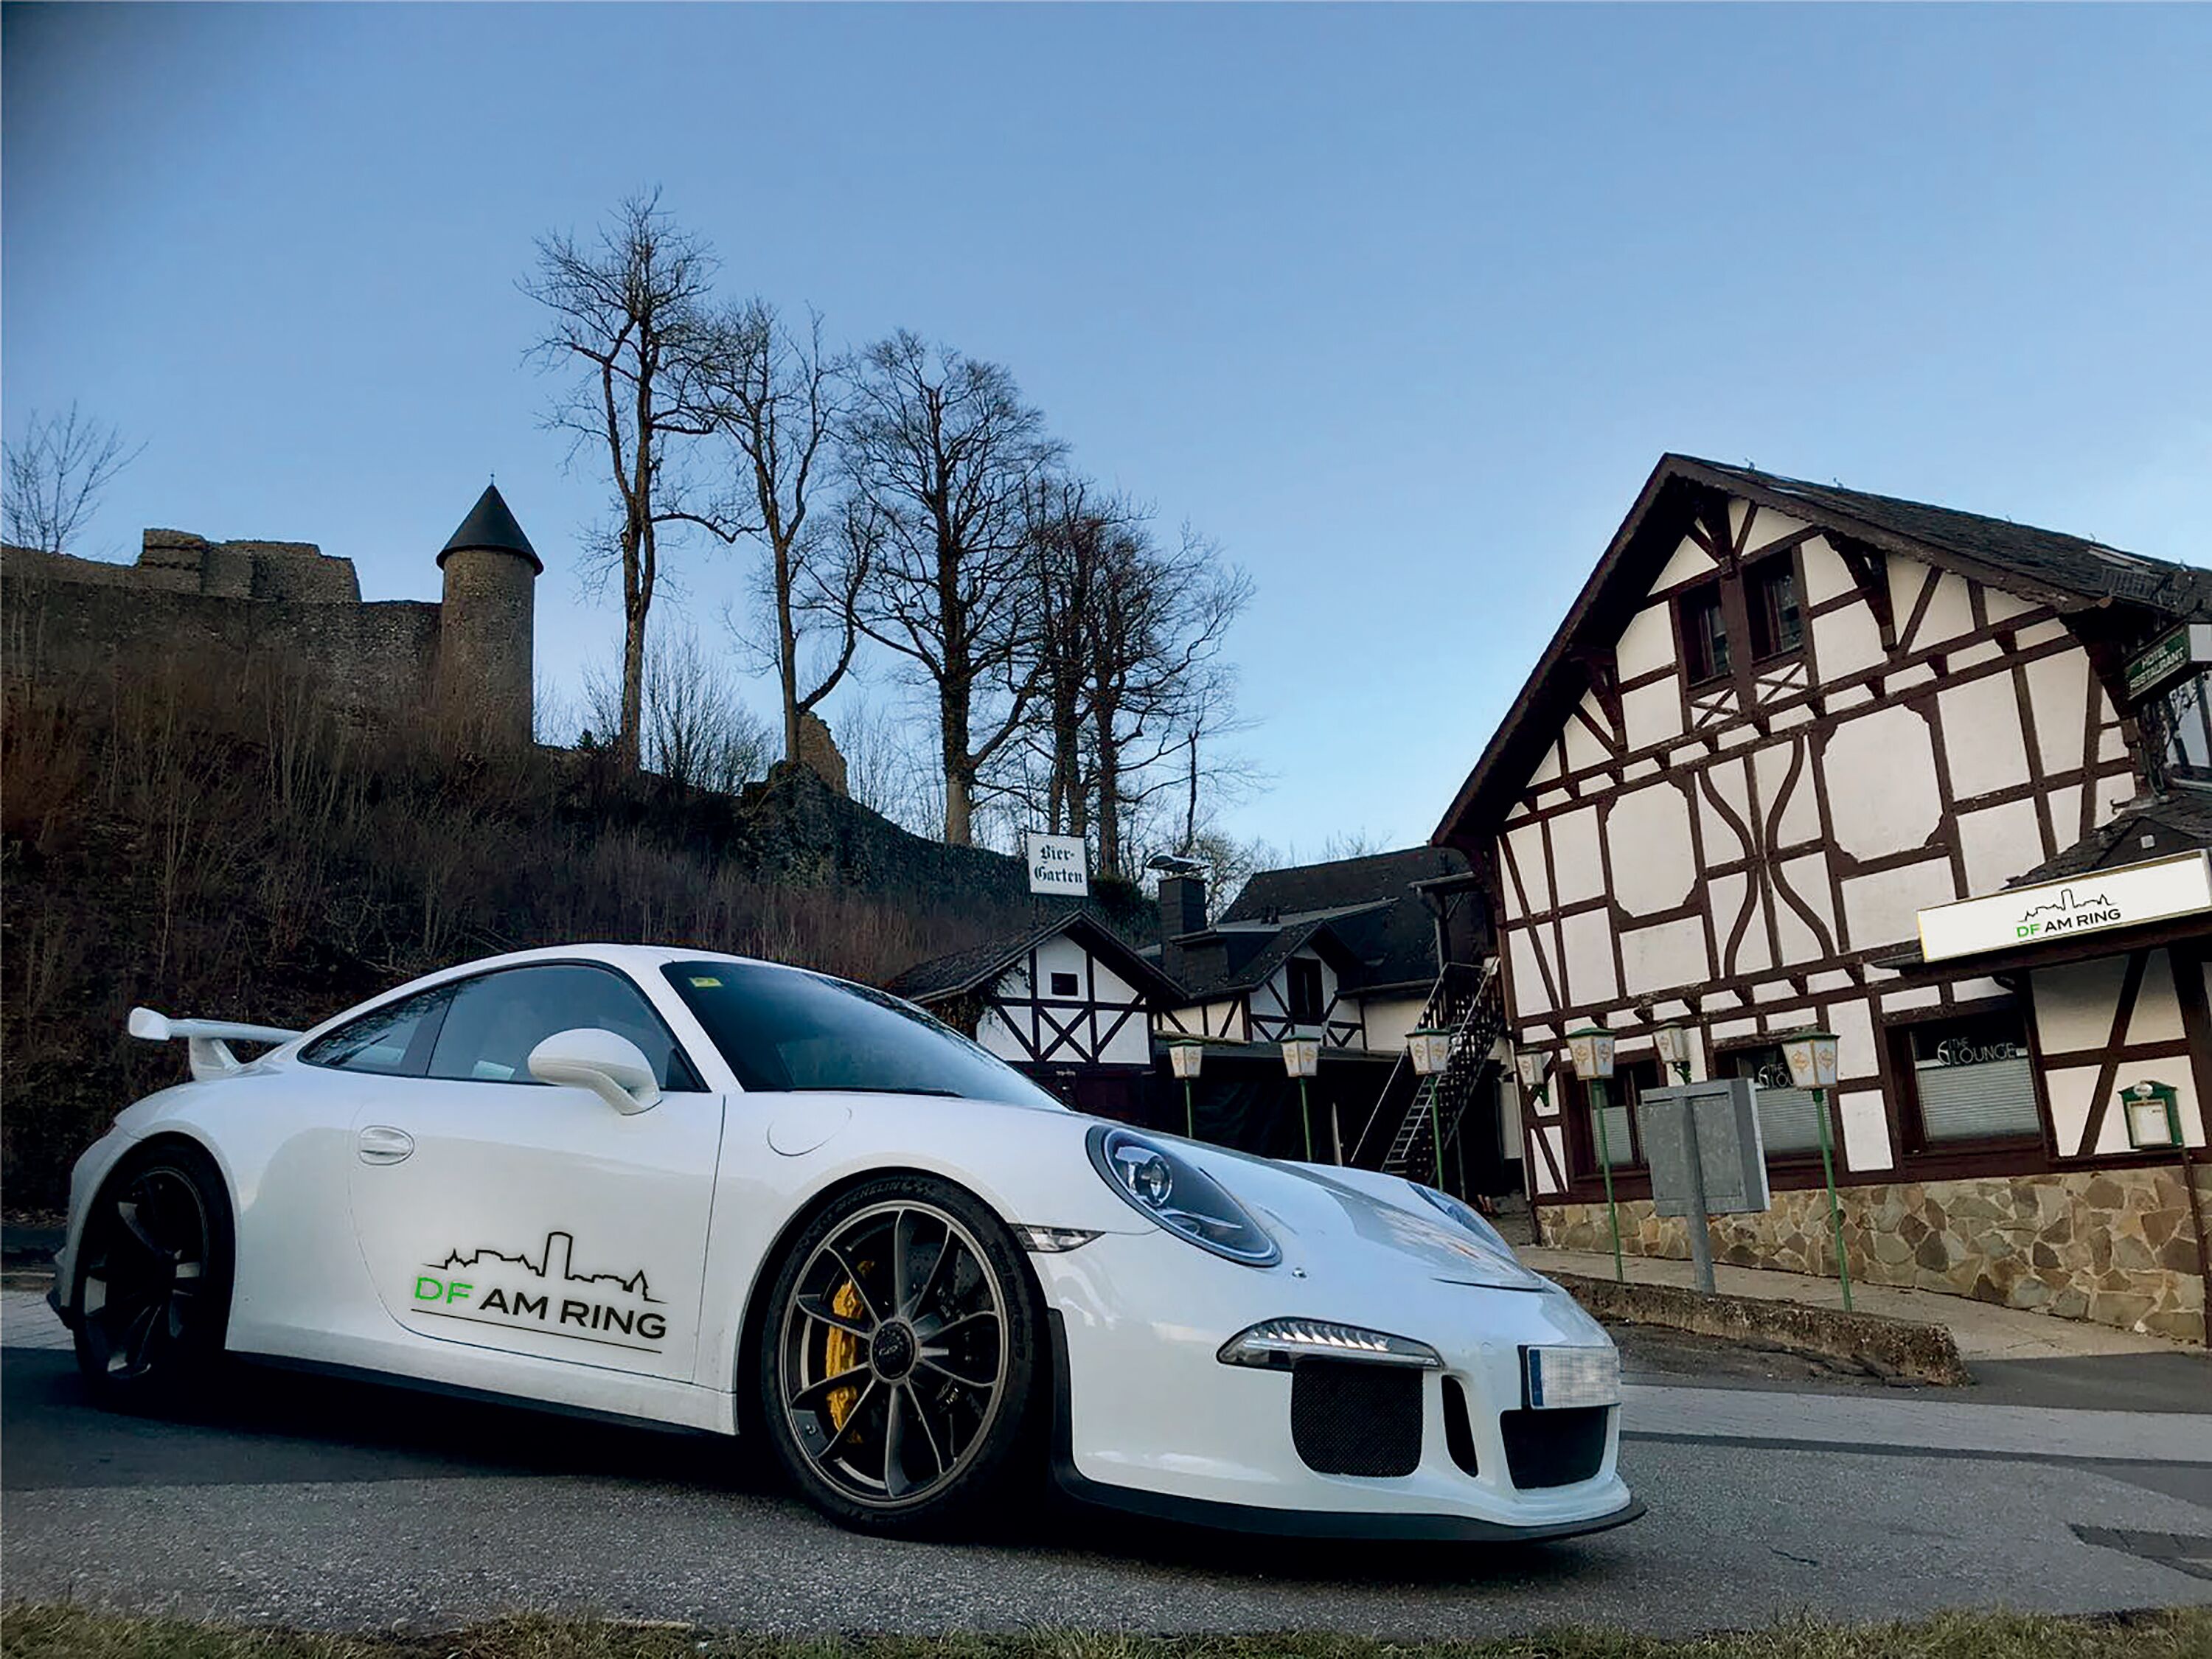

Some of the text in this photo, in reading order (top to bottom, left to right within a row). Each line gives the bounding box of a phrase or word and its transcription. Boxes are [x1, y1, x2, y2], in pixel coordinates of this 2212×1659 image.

[1040, 845, 1075, 861] Bier-
[1034, 866, 1083, 883] Garten
[2016, 908, 2121, 938] DF AM RING
[1952, 1042, 2015, 1065] LOUNGE
[1770, 1072, 1794, 1088] LOU
[414, 1276, 667, 1340] DF AM RING
